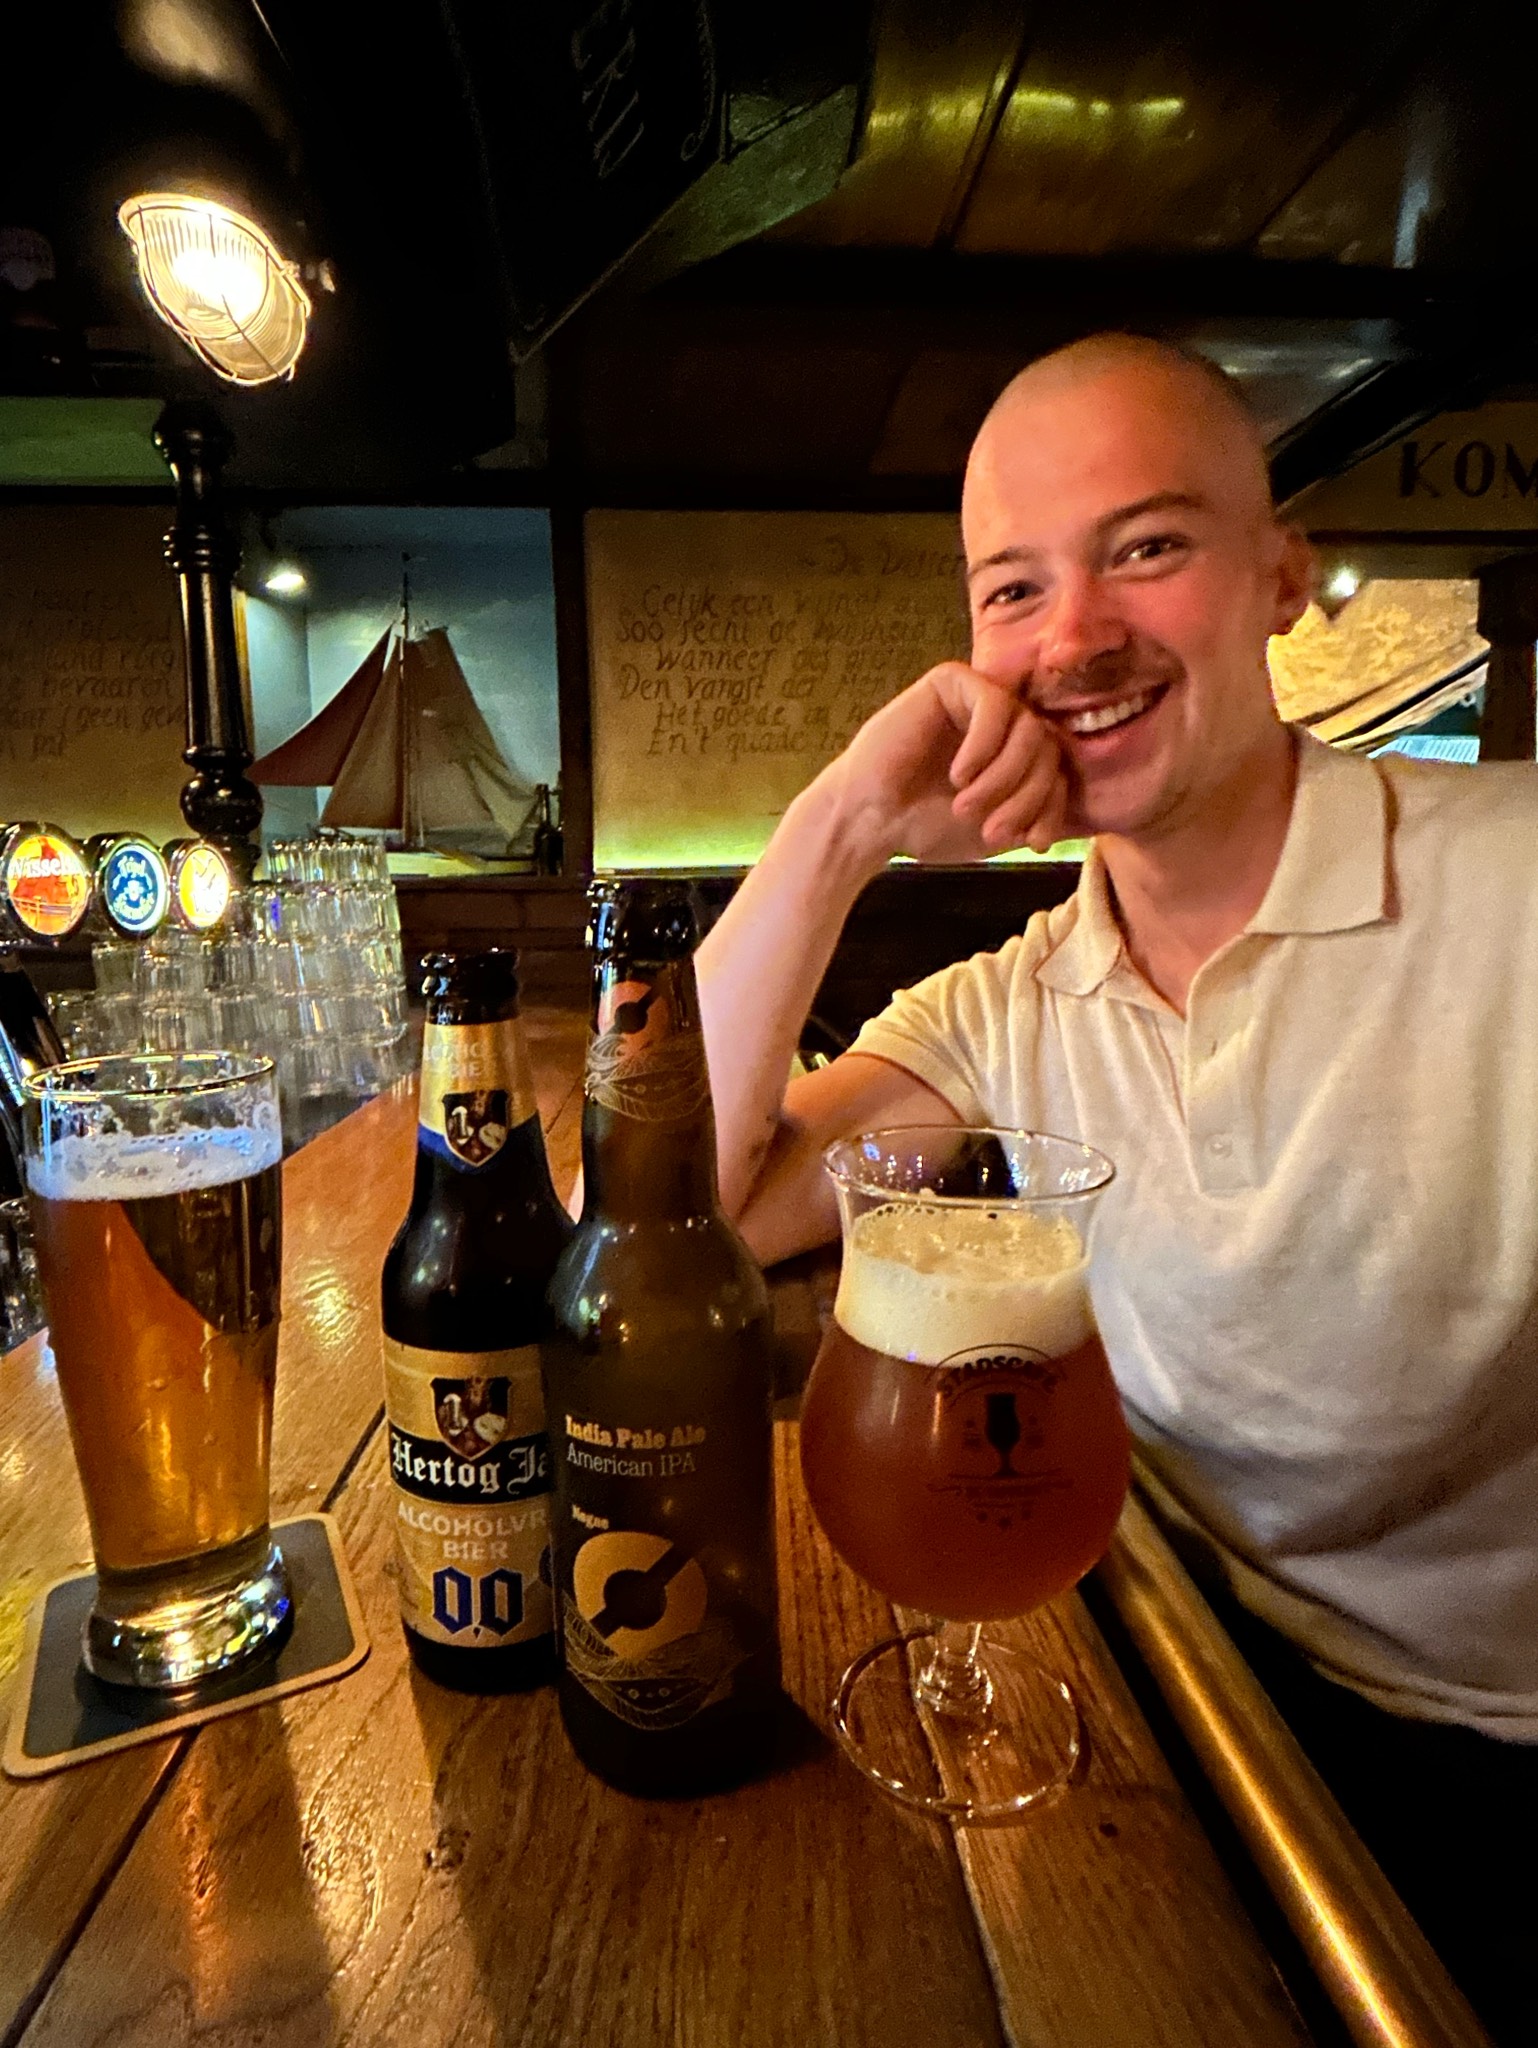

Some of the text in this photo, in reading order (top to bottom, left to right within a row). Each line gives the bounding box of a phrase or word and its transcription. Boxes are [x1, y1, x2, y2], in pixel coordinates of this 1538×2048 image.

[565, 1414, 706, 1450] India Pale Ale
[391, 1432, 501, 1494] Hertog
[566, 1442, 697, 1477] American IPA
[443, 1540, 509, 1561] BIER
